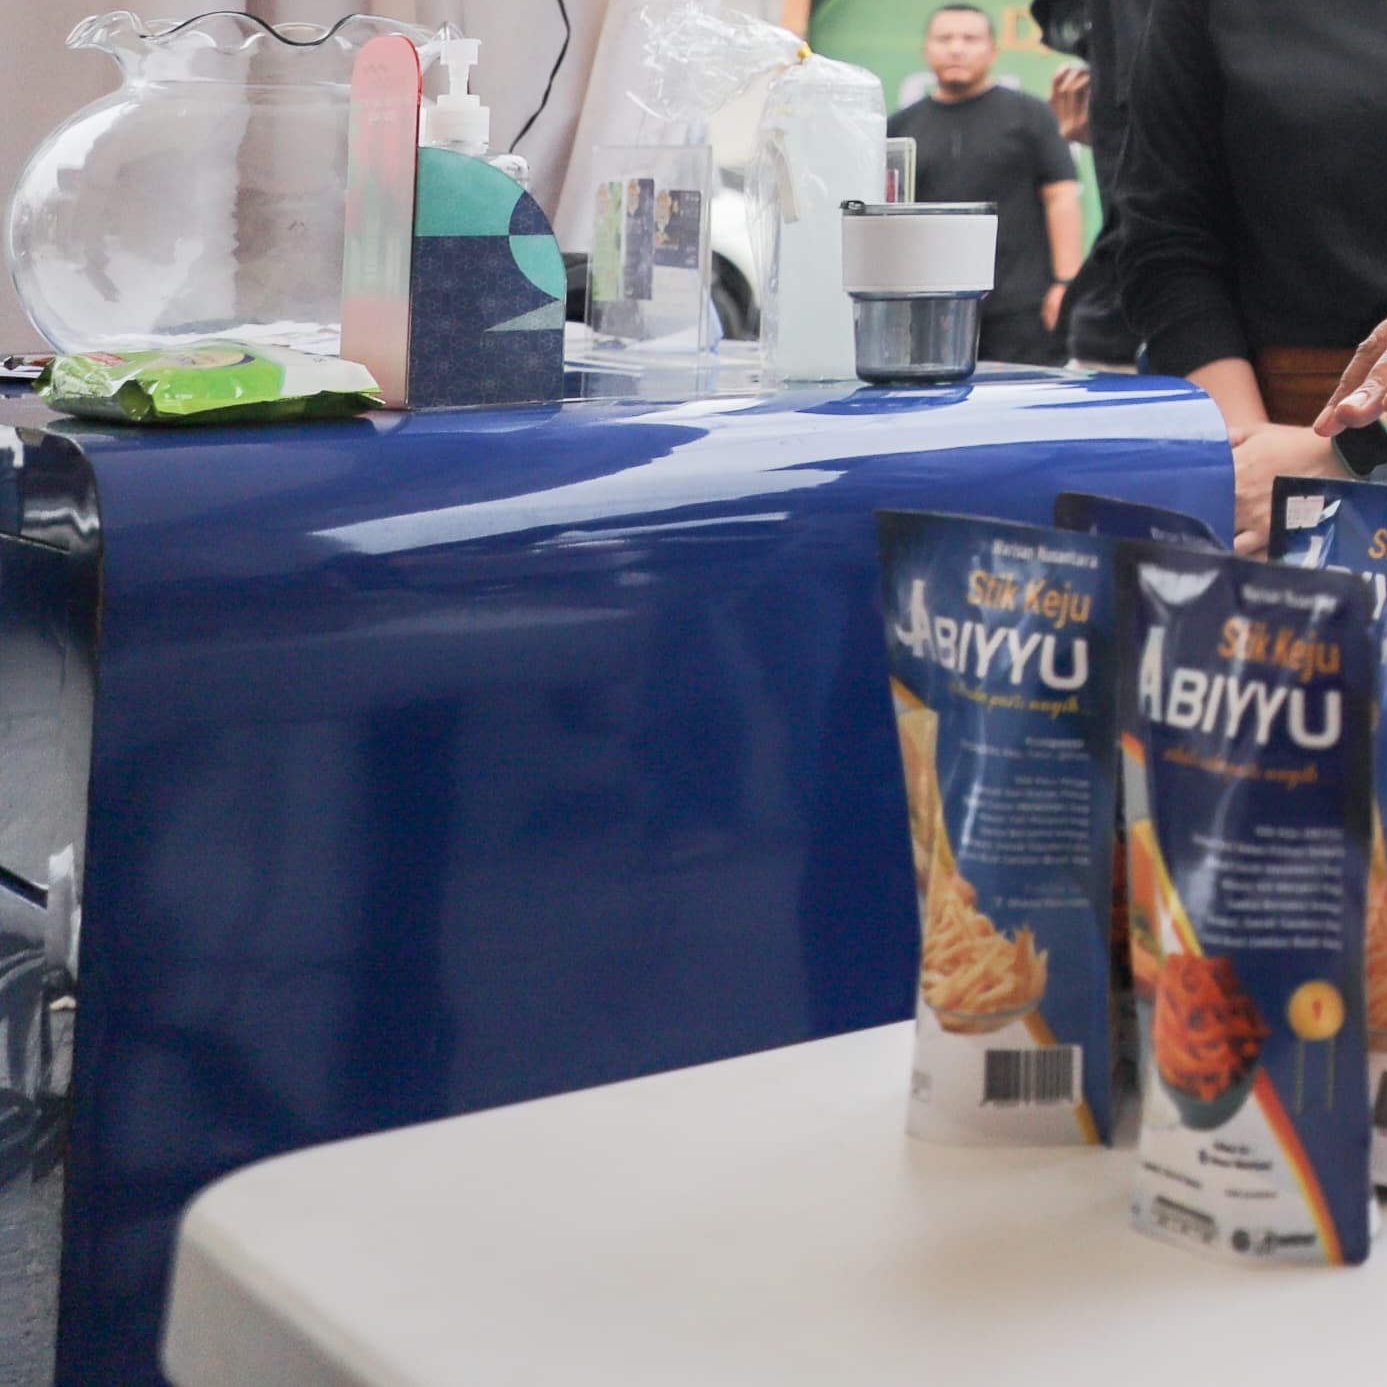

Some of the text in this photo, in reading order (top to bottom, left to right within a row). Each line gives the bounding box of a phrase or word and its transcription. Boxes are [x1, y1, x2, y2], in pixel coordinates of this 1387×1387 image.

[895, 577, 1090, 691] ABIYYU
[967, 568, 1092, 630] Stik Keju
[1138, 626, 1342, 750] ABIYYU
